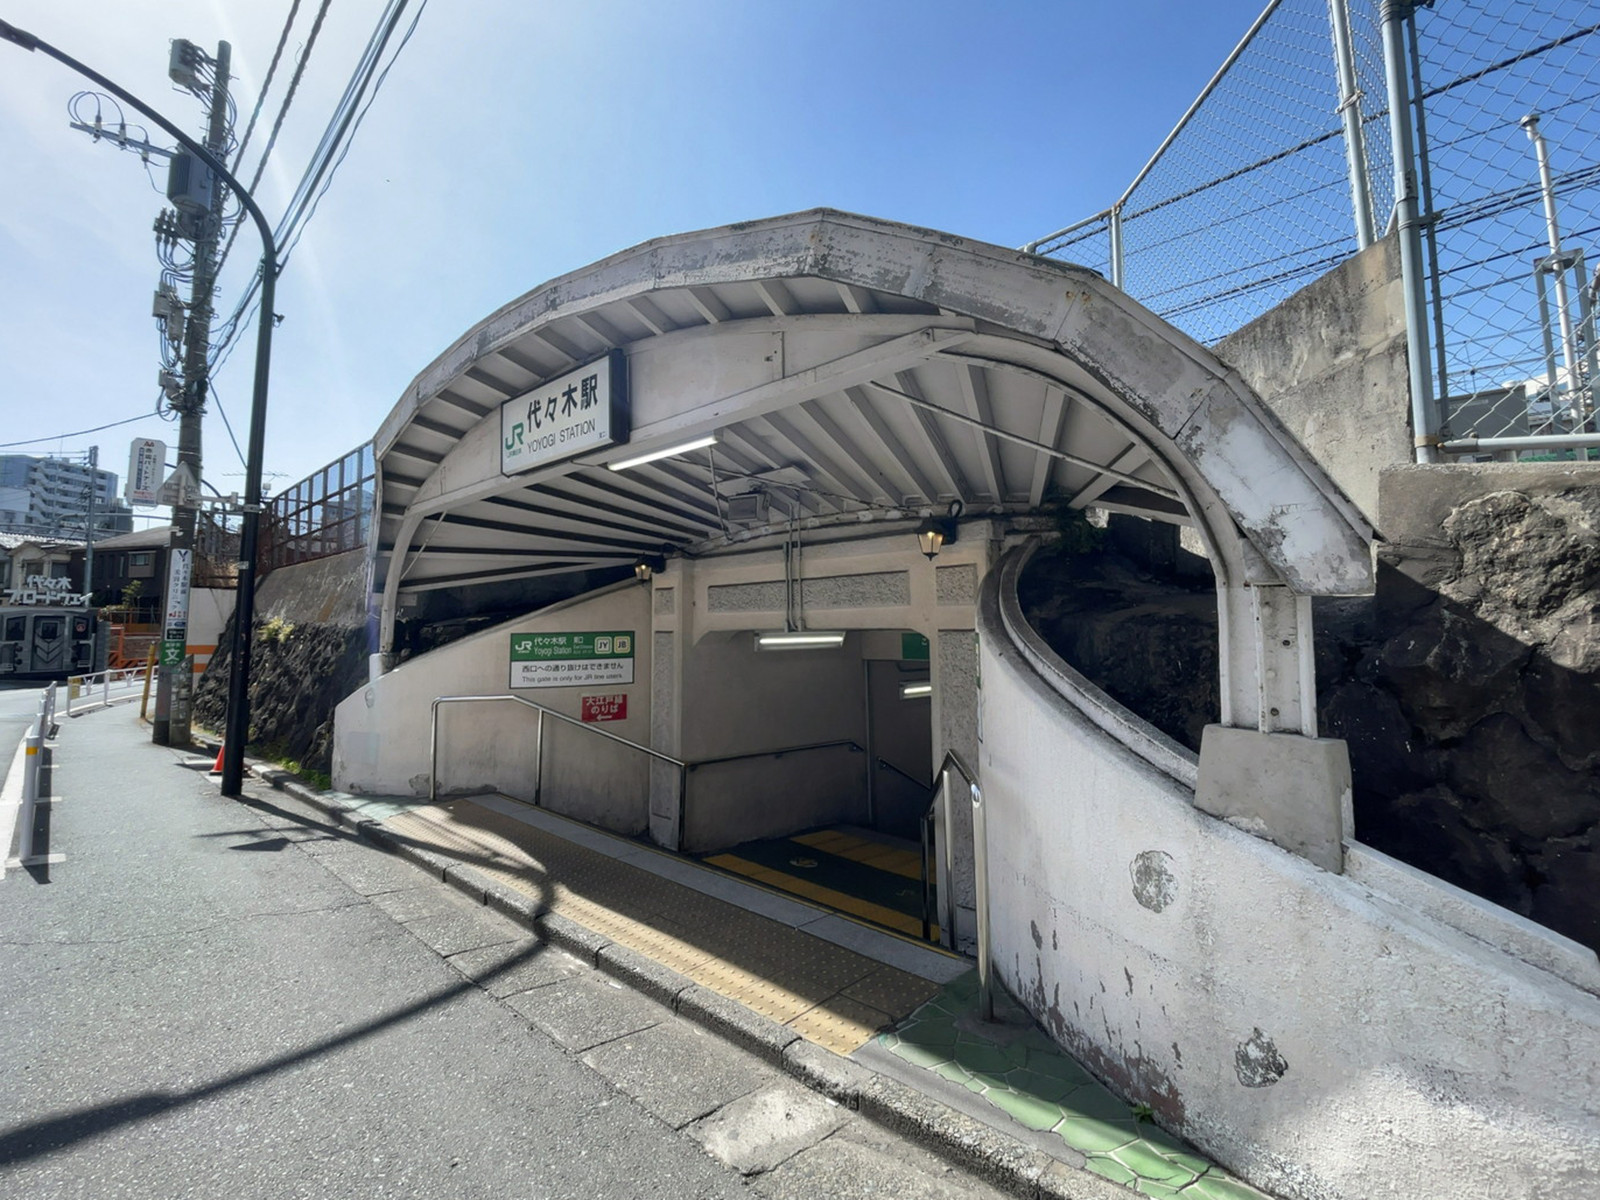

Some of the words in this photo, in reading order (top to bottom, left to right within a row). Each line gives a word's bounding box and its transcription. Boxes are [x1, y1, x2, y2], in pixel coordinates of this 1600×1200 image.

[527, 373, 598, 433] 代々木駅
[505, 422, 525, 450] JR
[526, 433, 556, 454] YOYOGI
[560, 418, 596, 443] STATION
[26, 574, 72, 589] 代々木
[515, 641, 532, 650] JR
[534, 637, 567, 645] 代々木駅
